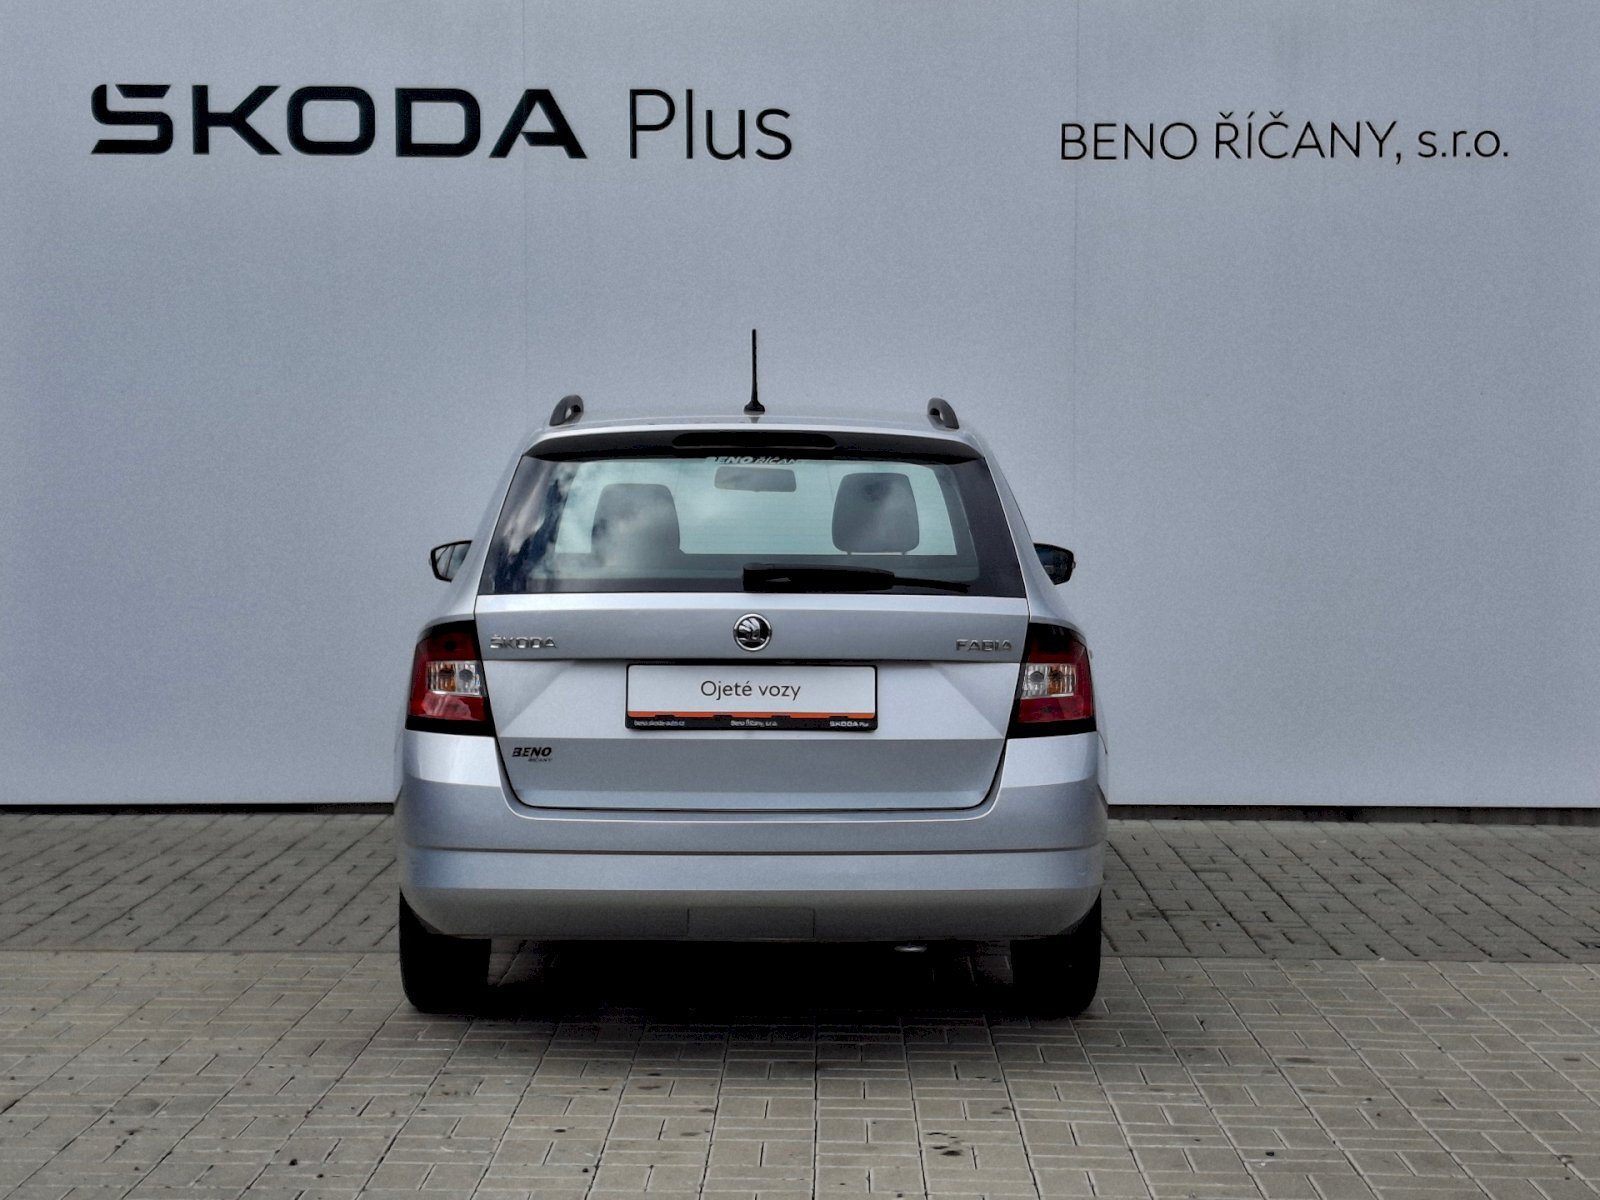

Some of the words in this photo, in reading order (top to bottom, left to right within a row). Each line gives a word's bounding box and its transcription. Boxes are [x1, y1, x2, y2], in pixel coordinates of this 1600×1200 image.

[630, 89, 792, 160] Plus
[1061, 122, 1197, 160] BENO
[1216, 111, 1402, 165] ŘÍČANY,
[1418, 130, 1509, 159] s.r.o.
[956, 639, 1013, 651] FABIA
[701, 680, 752, 701] Ojeté
[758, 685, 801, 702] vozy
[512, 747, 552, 757] BENO
